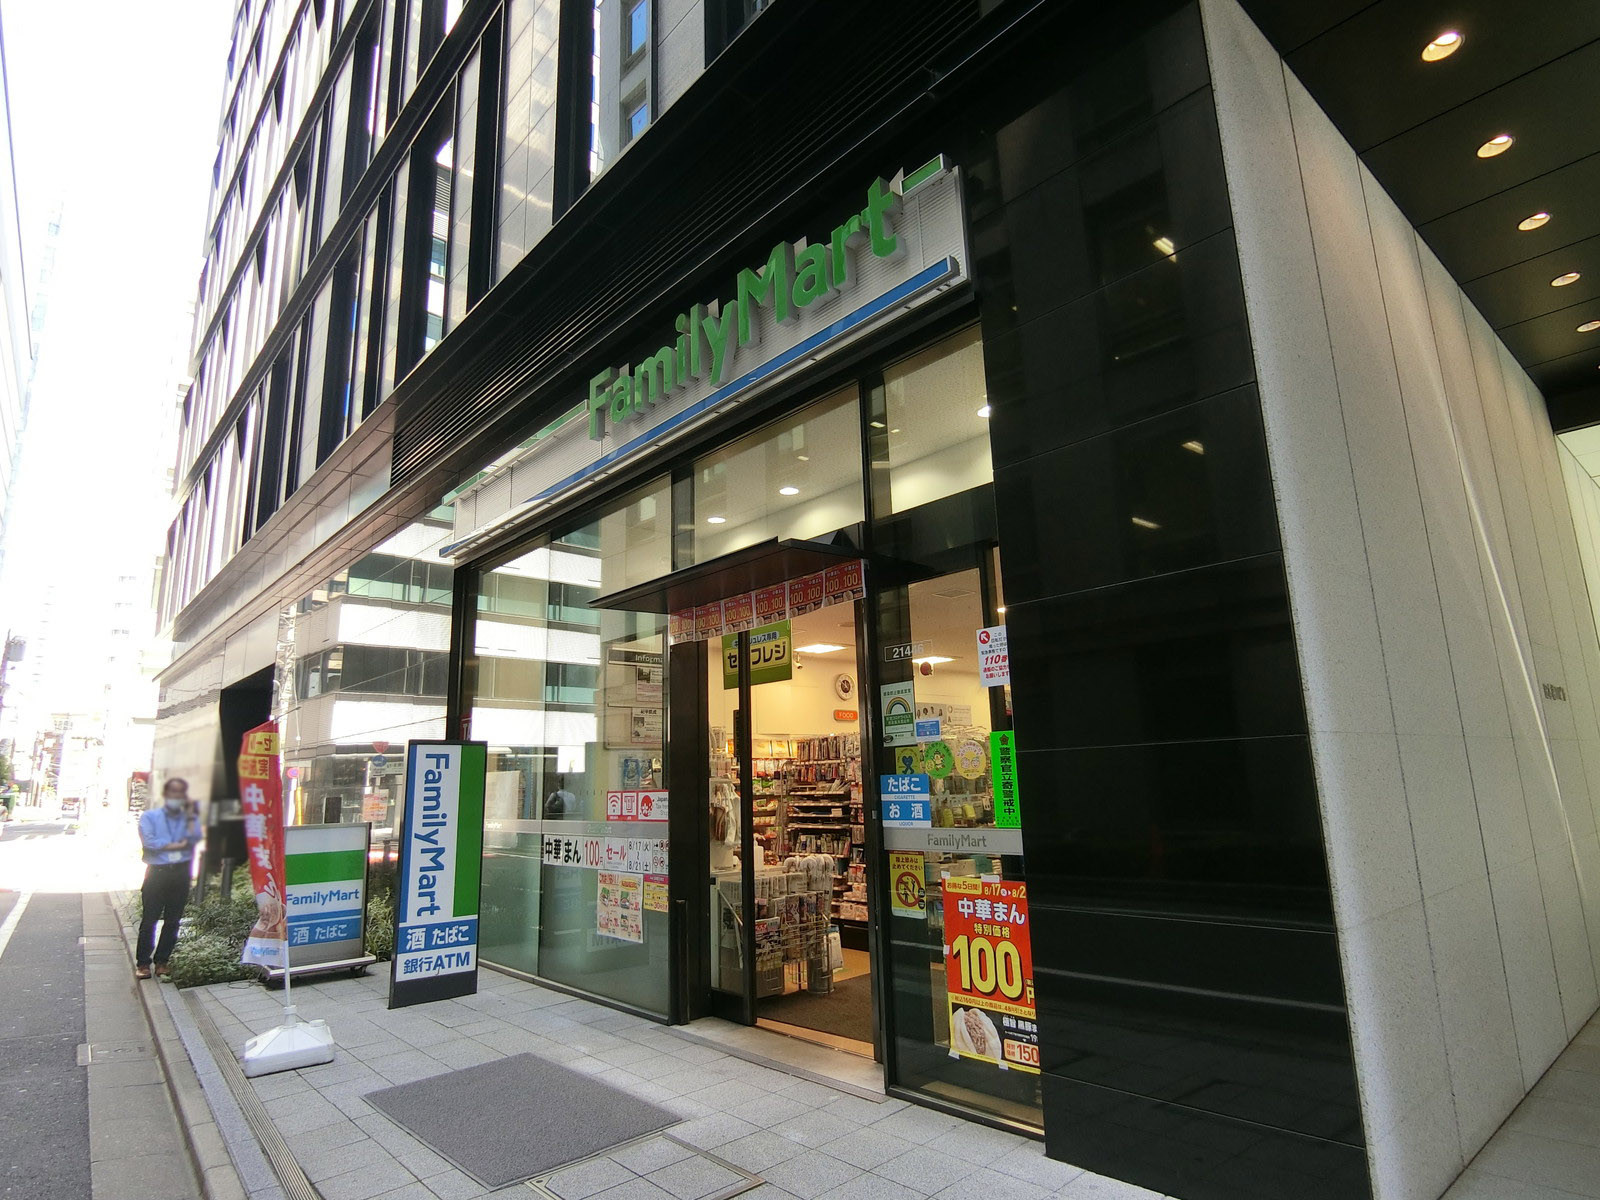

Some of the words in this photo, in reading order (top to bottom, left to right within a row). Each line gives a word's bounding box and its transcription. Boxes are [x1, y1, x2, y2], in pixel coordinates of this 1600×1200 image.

[589, 176, 904, 441] FamilyMart
[826, 579, 839, 593] 100
[844, 573, 858, 587] 100
[790, 591, 803, 605] 100
[808, 586, 820, 600] 100
[728, 641, 786, 669] セフレジ
[888, 777, 921, 792] たばこ
[999, 747, 1016, 816] 警察官立寄警戒中
[889, 803, 900, 818] お
[911, 803, 924, 819] 酒
[415, 752, 450, 917] FamilyMart
[927, 833, 987, 849] FamilyMart
[606, 844, 627, 862] セール
[286, 889, 360, 906] FamilyMart
[958, 897, 1026, 925] 中華まん
[293, 926, 310, 944] 酒
[315, 924, 347, 940] たばこ
[406, 928, 426, 950] 酒
[432, 925, 469, 945] たばこ
[974, 923, 1010, 938] 特別価格
[404, 951, 470, 974] 銀行ATM
[953, 935, 1024, 999] 100
[1017, 1043, 1039, 1064] 150
